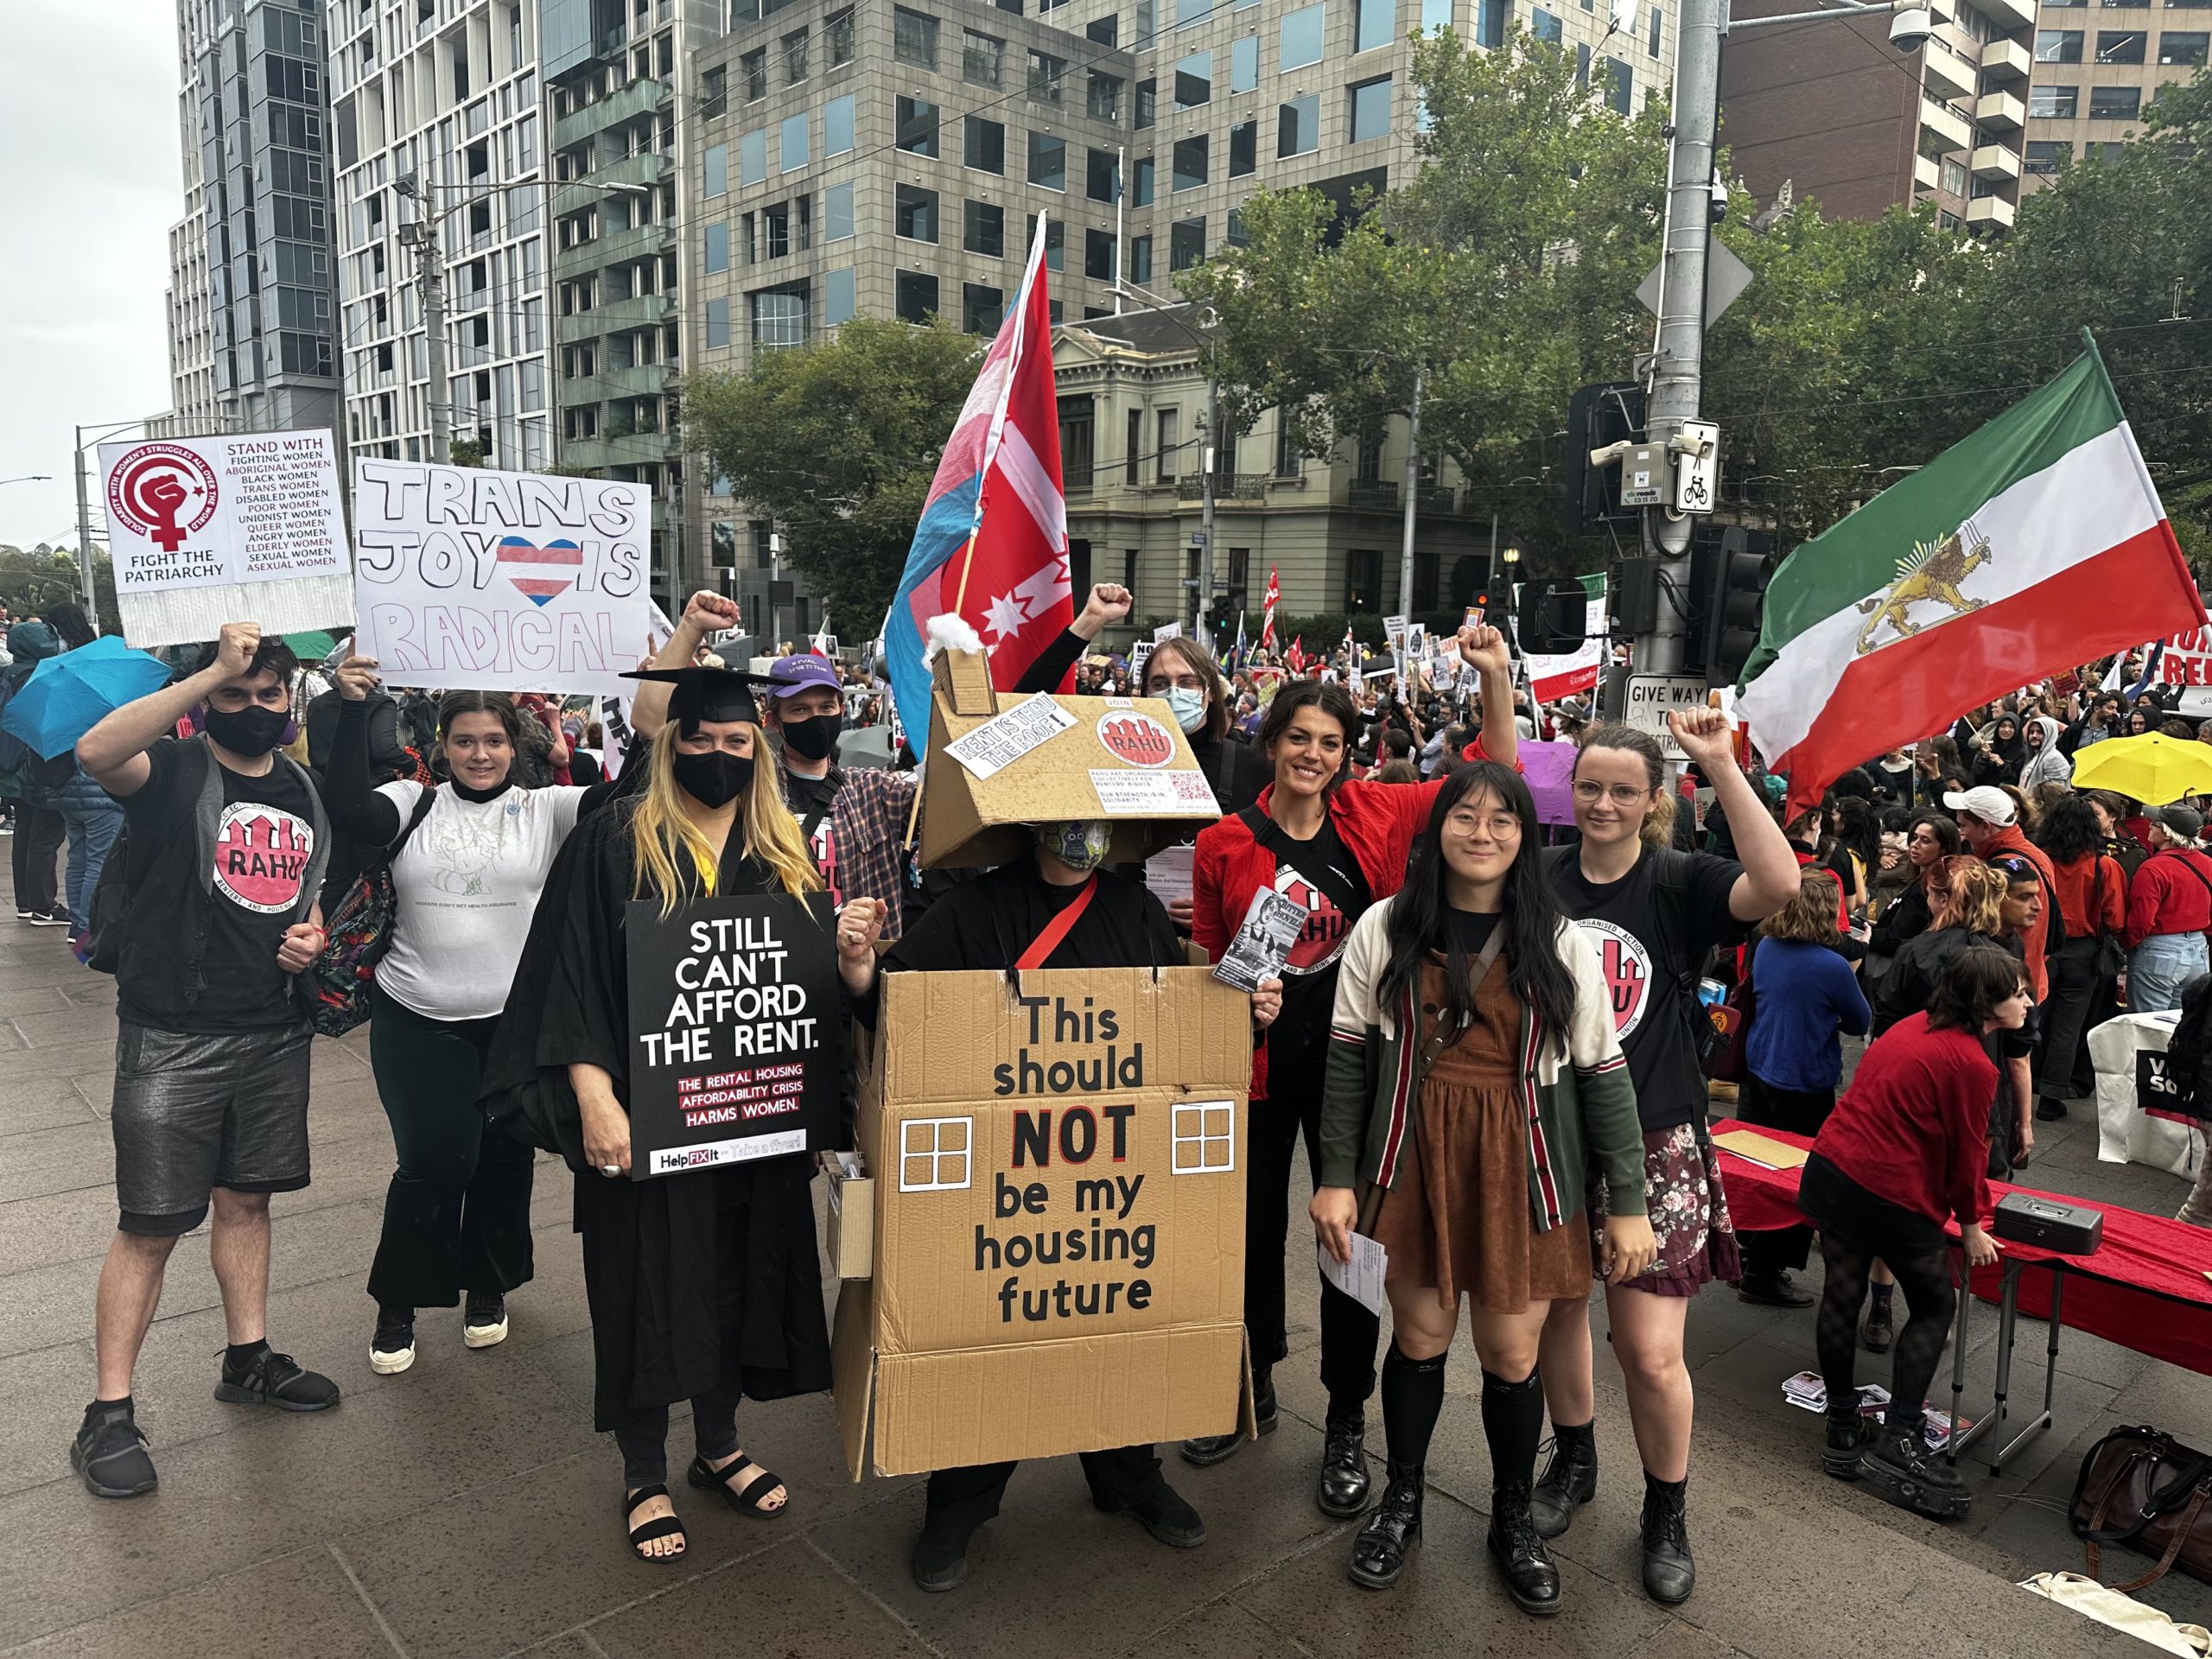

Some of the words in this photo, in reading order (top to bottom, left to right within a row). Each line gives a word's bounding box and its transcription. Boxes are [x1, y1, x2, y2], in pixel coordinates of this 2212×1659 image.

[147, 446, 194, 460] STRUGGLES
[228, 442, 277, 455] STAND
[283, 438, 322, 450] WITH
[115, 450, 145, 475] WOMEN'S
[193, 458, 204, 470] ALL
[226, 464, 288, 475] ABORIGINAL
[291, 461, 331, 470] WOMEN
[232, 454, 279, 465] FIGHTING
[283, 451, 322, 461] WOMEN
[111, 477, 119, 496] WITH
[203, 470, 215, 489] OVER
[242, 474, 274, 484] BLACK
[278, 471, 317, 480] WOMEN
[243, 484, 276, 493] TRANS
[280, 480, 319, 490] WOMEN
[236, 493, 285, 504] DISABLED
[289, 490, 328, 499] WOMEN
[249, 504, 276, 512] POOR
[279, 500, 319, 510] WOMEN
[362, 463, 635, 537] TRANS
[111, 499, 145, 533] SOLIDARITY
[192, 507, 213, 529] WORLD
[238, 512, 288, 523] UNIONIST
[291, 509, 331, 518] WOMEN
[248, 524, 282, 533] QUEER
[285, 519, 324, 529] WOMEN
[245, 542, 289, 552] ELDERLY
[293, 538, 332, 547] WOMEN
[249, 532, 283, 542] ANGRY
[287, 529, 326, 538] WOMEN
[130, 553, 178, 567] FIGHT
[183, 550, 213, 563] THE
[247, 561, 294, 572] ASEXUAL
[296, 557, 335, 567] WOMEN
[250, 552, 289, 562] SEXUAL
[292, 548, 331, 557] WOMEN
[359, 530, 504, 588] JOY
[576, 541, 640, 597] IS
[124, 564, 224, 582] PATRIARCHY
[372, 603, 639, 672] RADICAL
[1632, 686, 1666, 702] GIVE
[1673, 687, 1703, 702] WAY
[954, 727, 1001, 760] RENT
[995, 718, 1019, 735] IS
[1010, 696, 1056, 725] THRU
[980, 741, 1021, 767] THE
[1112, 737, 1166, 752] RAHU
[228, 849, 302, 880] RAHU
[217, 880, 242, 903] RENTERS
[1276, 911, 1303, 928] HOVELS
[1281, 899, 1307, 919] BITTER
[690, 917, 783, 953] STILL
[1577, 920, 1617, 931] ORGANISED
[1622, 933, 1645, 956] ACTION
[1303, 960, 1330, 974] HOUSING
[1333, 940, 1348, 957] UNION
[675, 951, 788, 989] CAN'T
[665, 984, 806, 1027] AFFORD
[1019, 996, 1119, 1044] This
[1620, 1017, 1638, 1036] UNION
[640, 1027, 712, 1066] THE
[734, 1018, 818, 1057] RENT.
[679, 1079, 701, 1090] THE
[706, 1072, 751, 1088] RENTAL
[756, 1065, 803, 1080] HOUSING
[994, 1043, 1143, 1096] should
[682, 1087, 768, 1108] AFFORDABILITY
[772, 1081, 804, 1095] CRISIS
[686, 1107, 737, 1126] HARMS
[743, 1098, 798, 1117] WOMEN.
[730, 1144, 755, 1158] Take
[761, 1143, 768, 1153] a
[770, 1136, 801, 1154] flyer!
[1012, 1104, 1135, 1168] NOT
[995, 1173, 1049, 1218] be
[1076, 1175, 1145, 1220] my
[975, 1218, 1155, 1271] housing
[998, 1276, 1152, 1323] future
